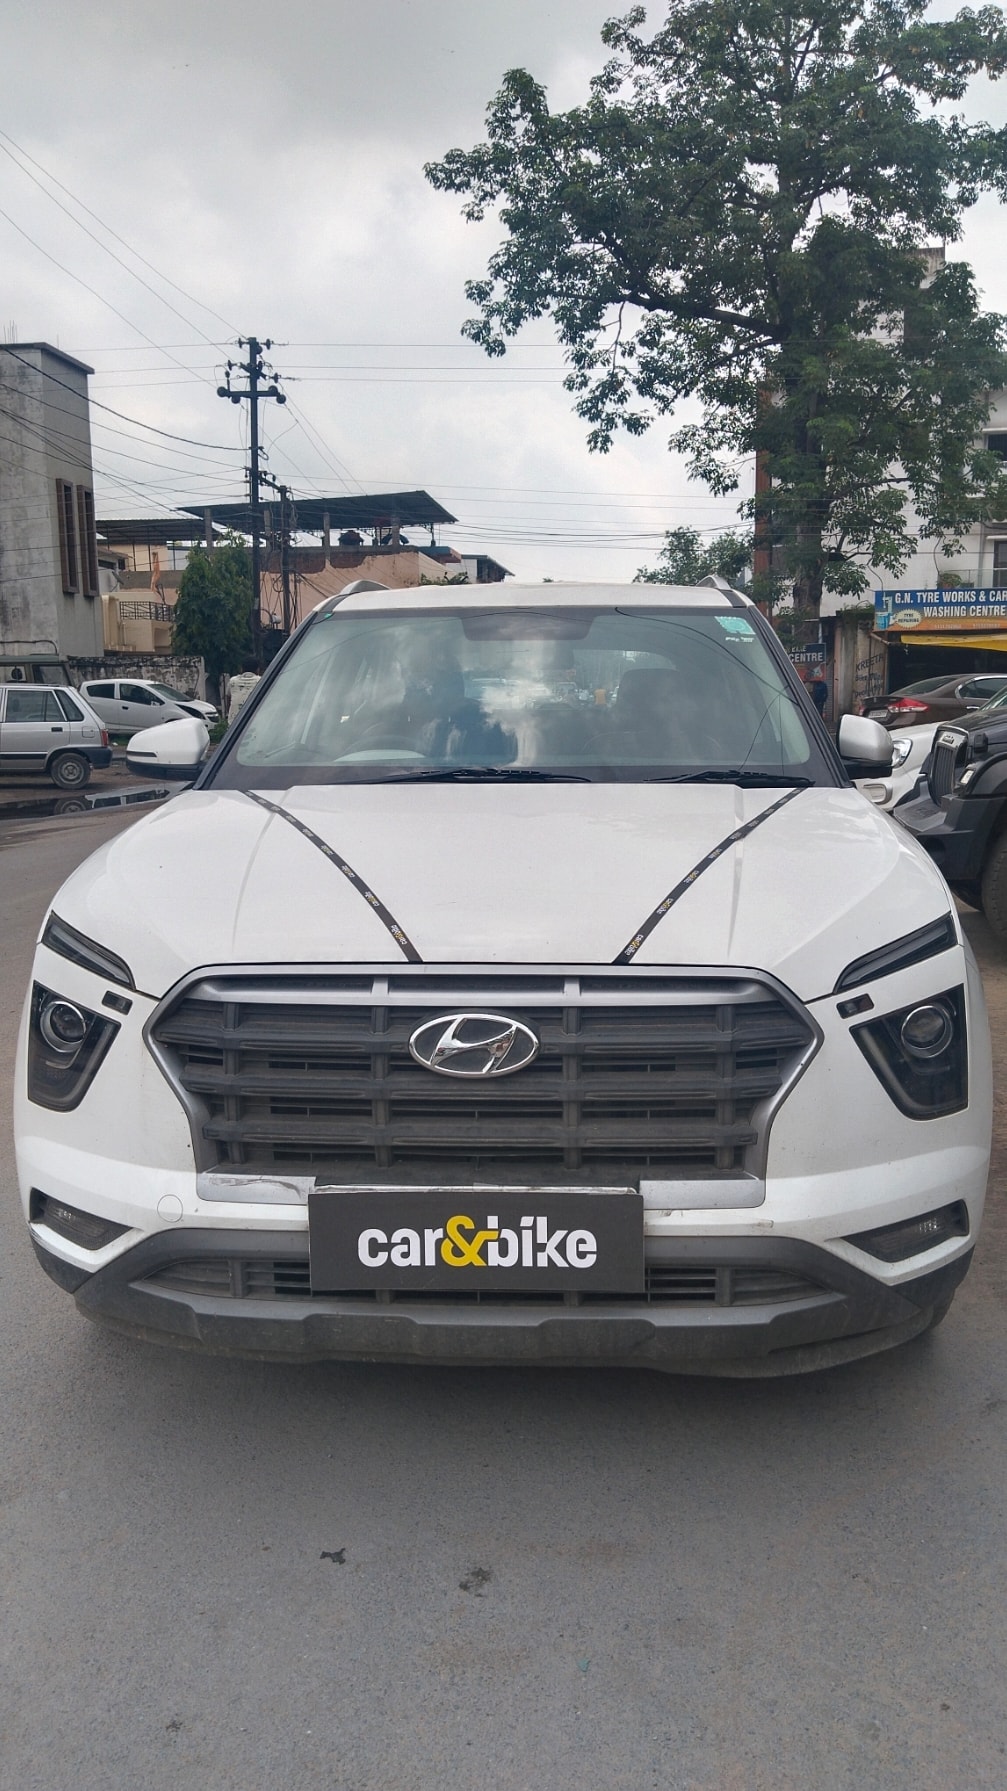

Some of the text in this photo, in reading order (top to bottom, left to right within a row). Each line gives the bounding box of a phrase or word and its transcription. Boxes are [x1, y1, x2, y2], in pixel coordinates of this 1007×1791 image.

[895, 592, 914, 604] G.N.
[917, 591, 939, 603] TYRE
[942, 591, 976, 603] WORKS
[979, 590, 986, 602] &
[923, 604, 1006, 617] WASHING CENTRE
[788, 652, 823, 662] CENTRE
[357, 1215, 597, 1268] car&bike
